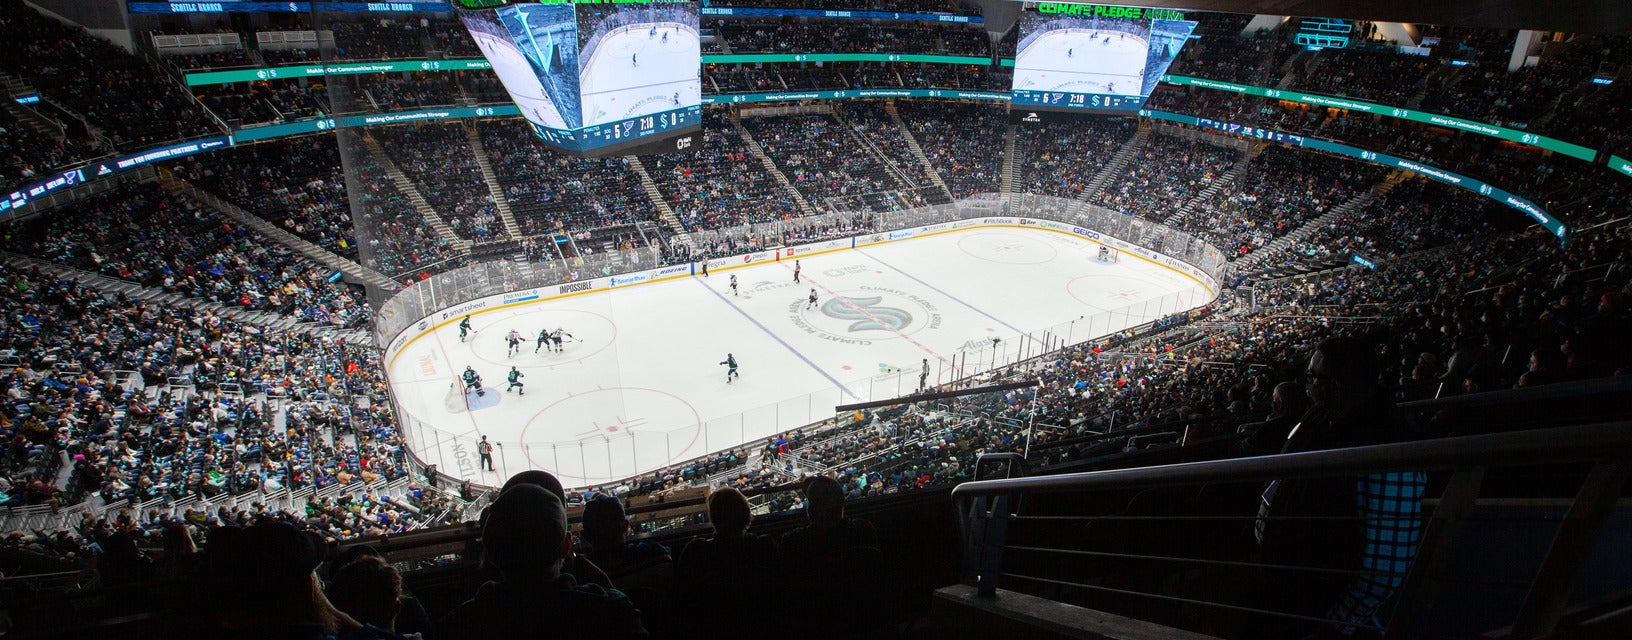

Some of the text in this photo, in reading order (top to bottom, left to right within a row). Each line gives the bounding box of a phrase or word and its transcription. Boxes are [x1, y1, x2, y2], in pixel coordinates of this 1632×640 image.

[1038, 2, 1184, 20] CLIMATE PLEDGE ARENA
[1070, 94, 1084, 103] 7:18
[1104, 96, 1110, 106] 0
[614, 124, 620, 139] 5
[640, 117, 654, 130] 7:18
[672, 112, 676, 126] 0
[1073, 227, 1099, 240] GEICO
[660, 267, 687, 275] BOEING
[559, 281, 592, 294] IMPOSSIBLE
[860, 285, 908, 295] CLIMATE
[450, 302, 486, 317] smartsheet
[817, 333, 872, 346] CLIMATE
